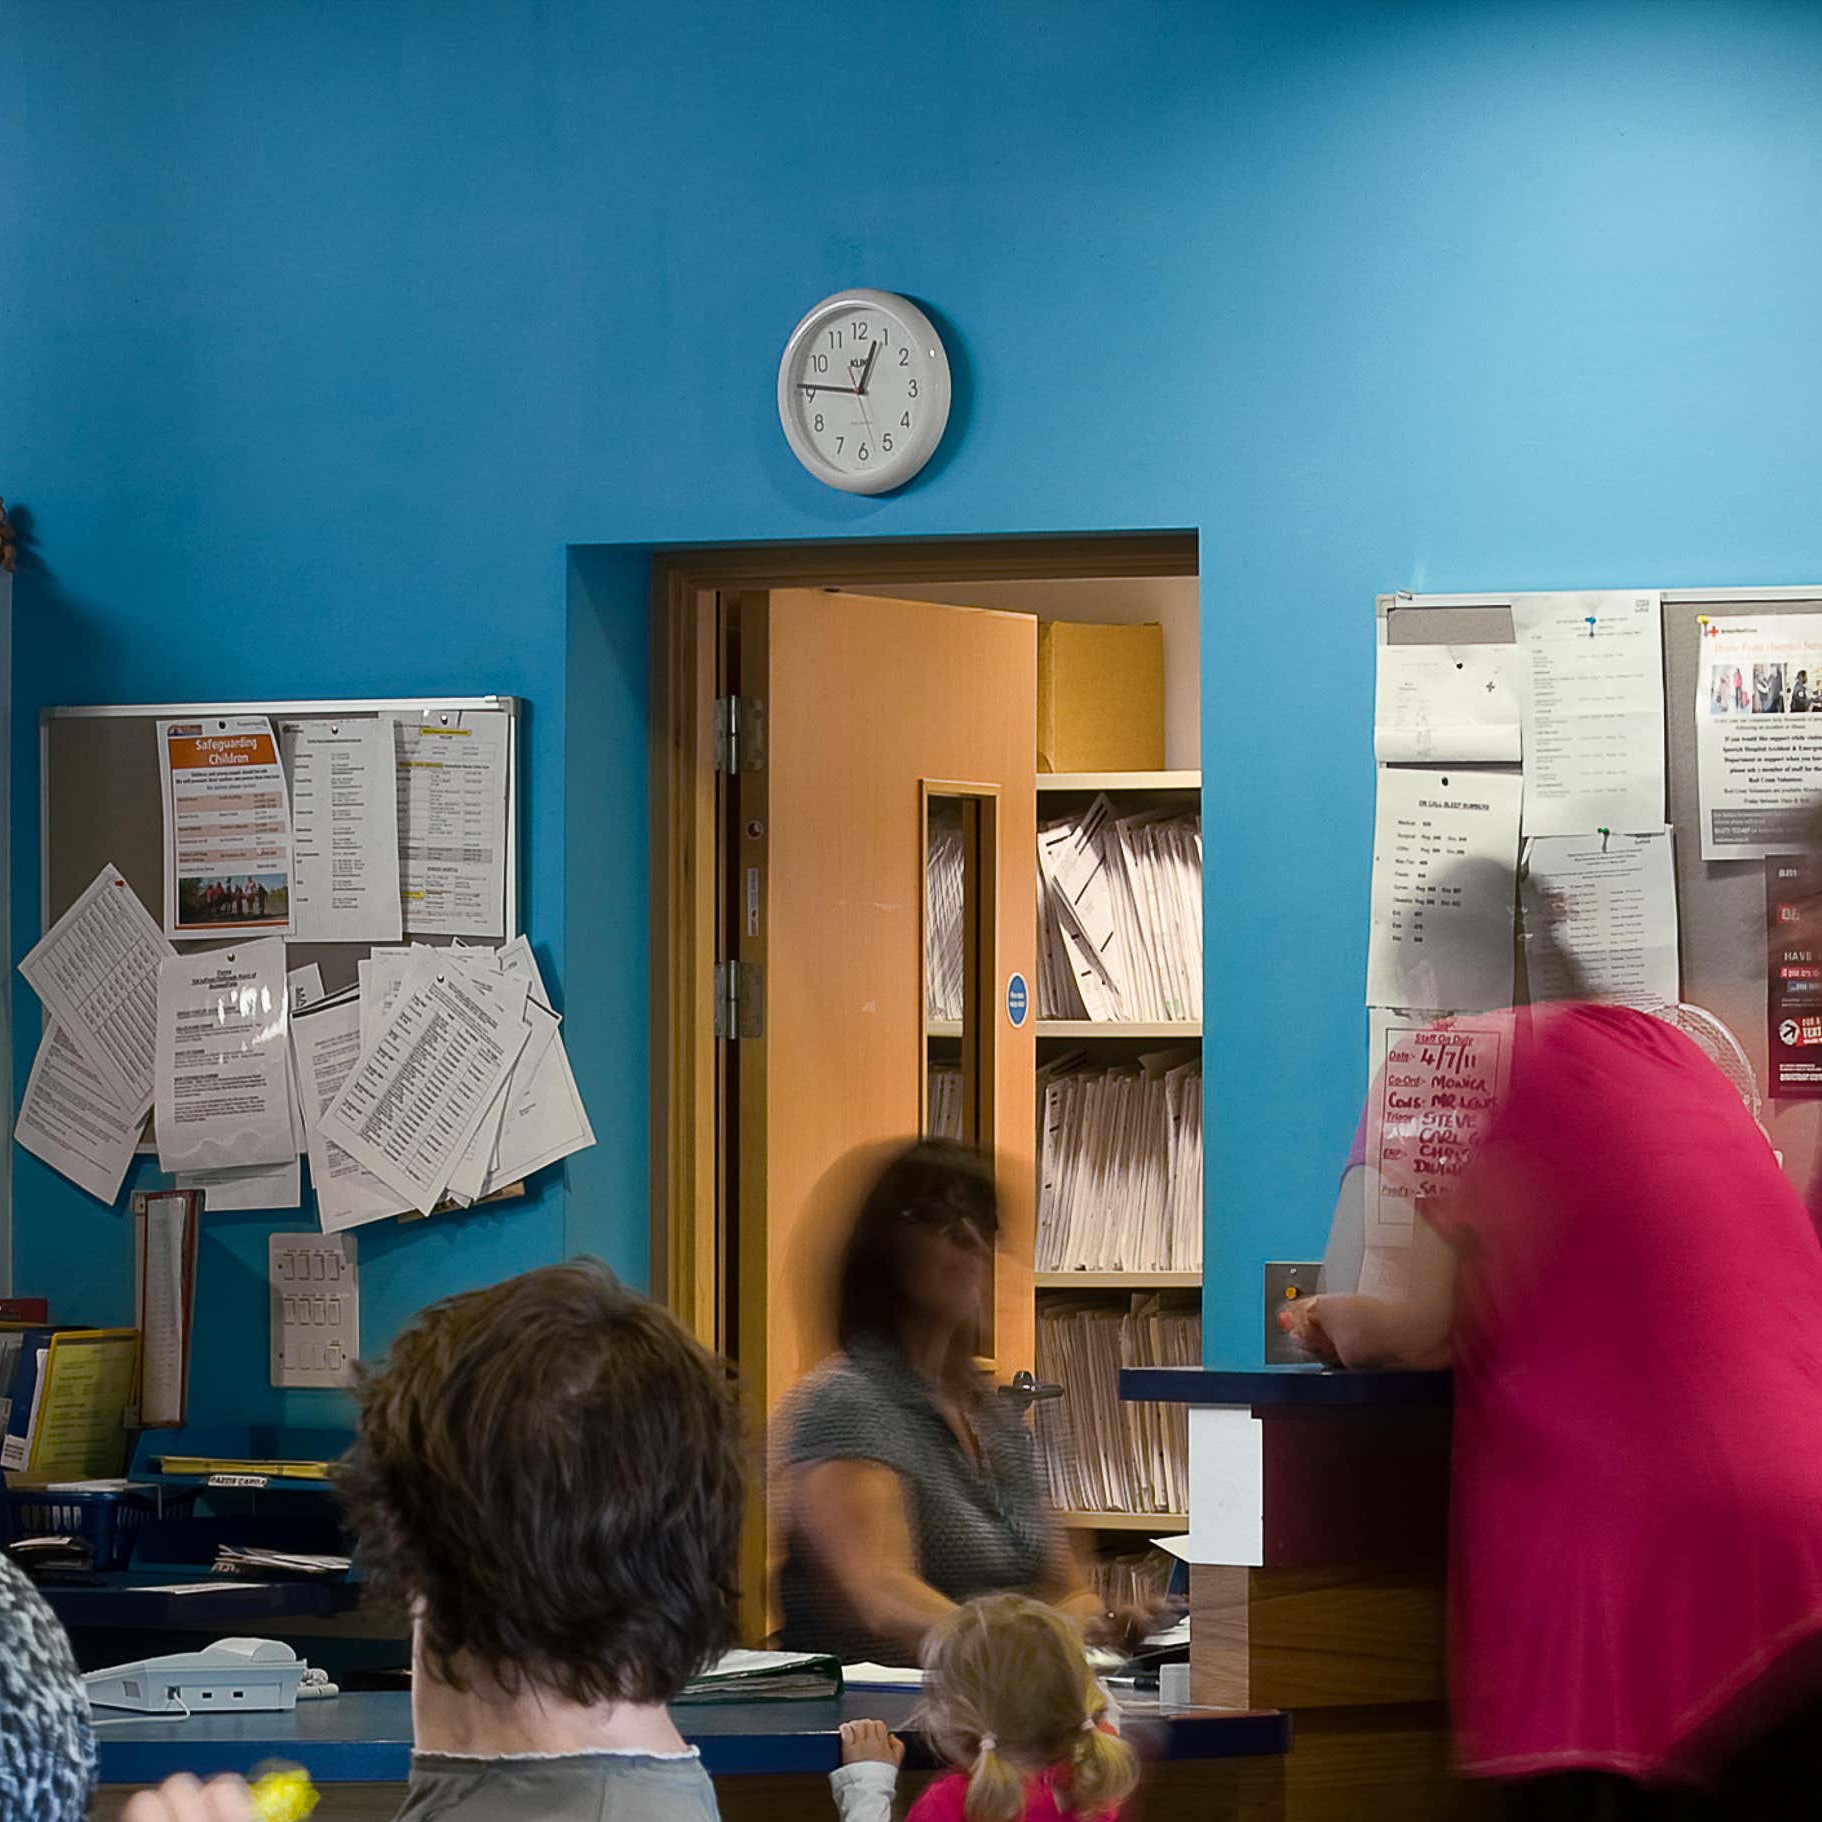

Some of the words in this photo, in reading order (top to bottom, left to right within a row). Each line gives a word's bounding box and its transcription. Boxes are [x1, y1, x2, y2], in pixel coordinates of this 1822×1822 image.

[829, 331, 842, 349] 11
[851, 323, 868, 340] 12
[883, 328, 889, 345] 1
[812, 355, 827, 372] 10
[899, 348, 908, 366] 2
[908, 379, 918, 397] 3
[815, 414, 824, 432] 8
[900, 412, 909, 428] 4
[836, 437, 844, 454] 7
[882, 434, 893, 451] 5
[858, 443, 868, 460] 6
[196, 737, 257, 751] Safeguarding
[209, 753, 249, 765] Children
[1420, 1044, 1476, 1074] 4/7/11
